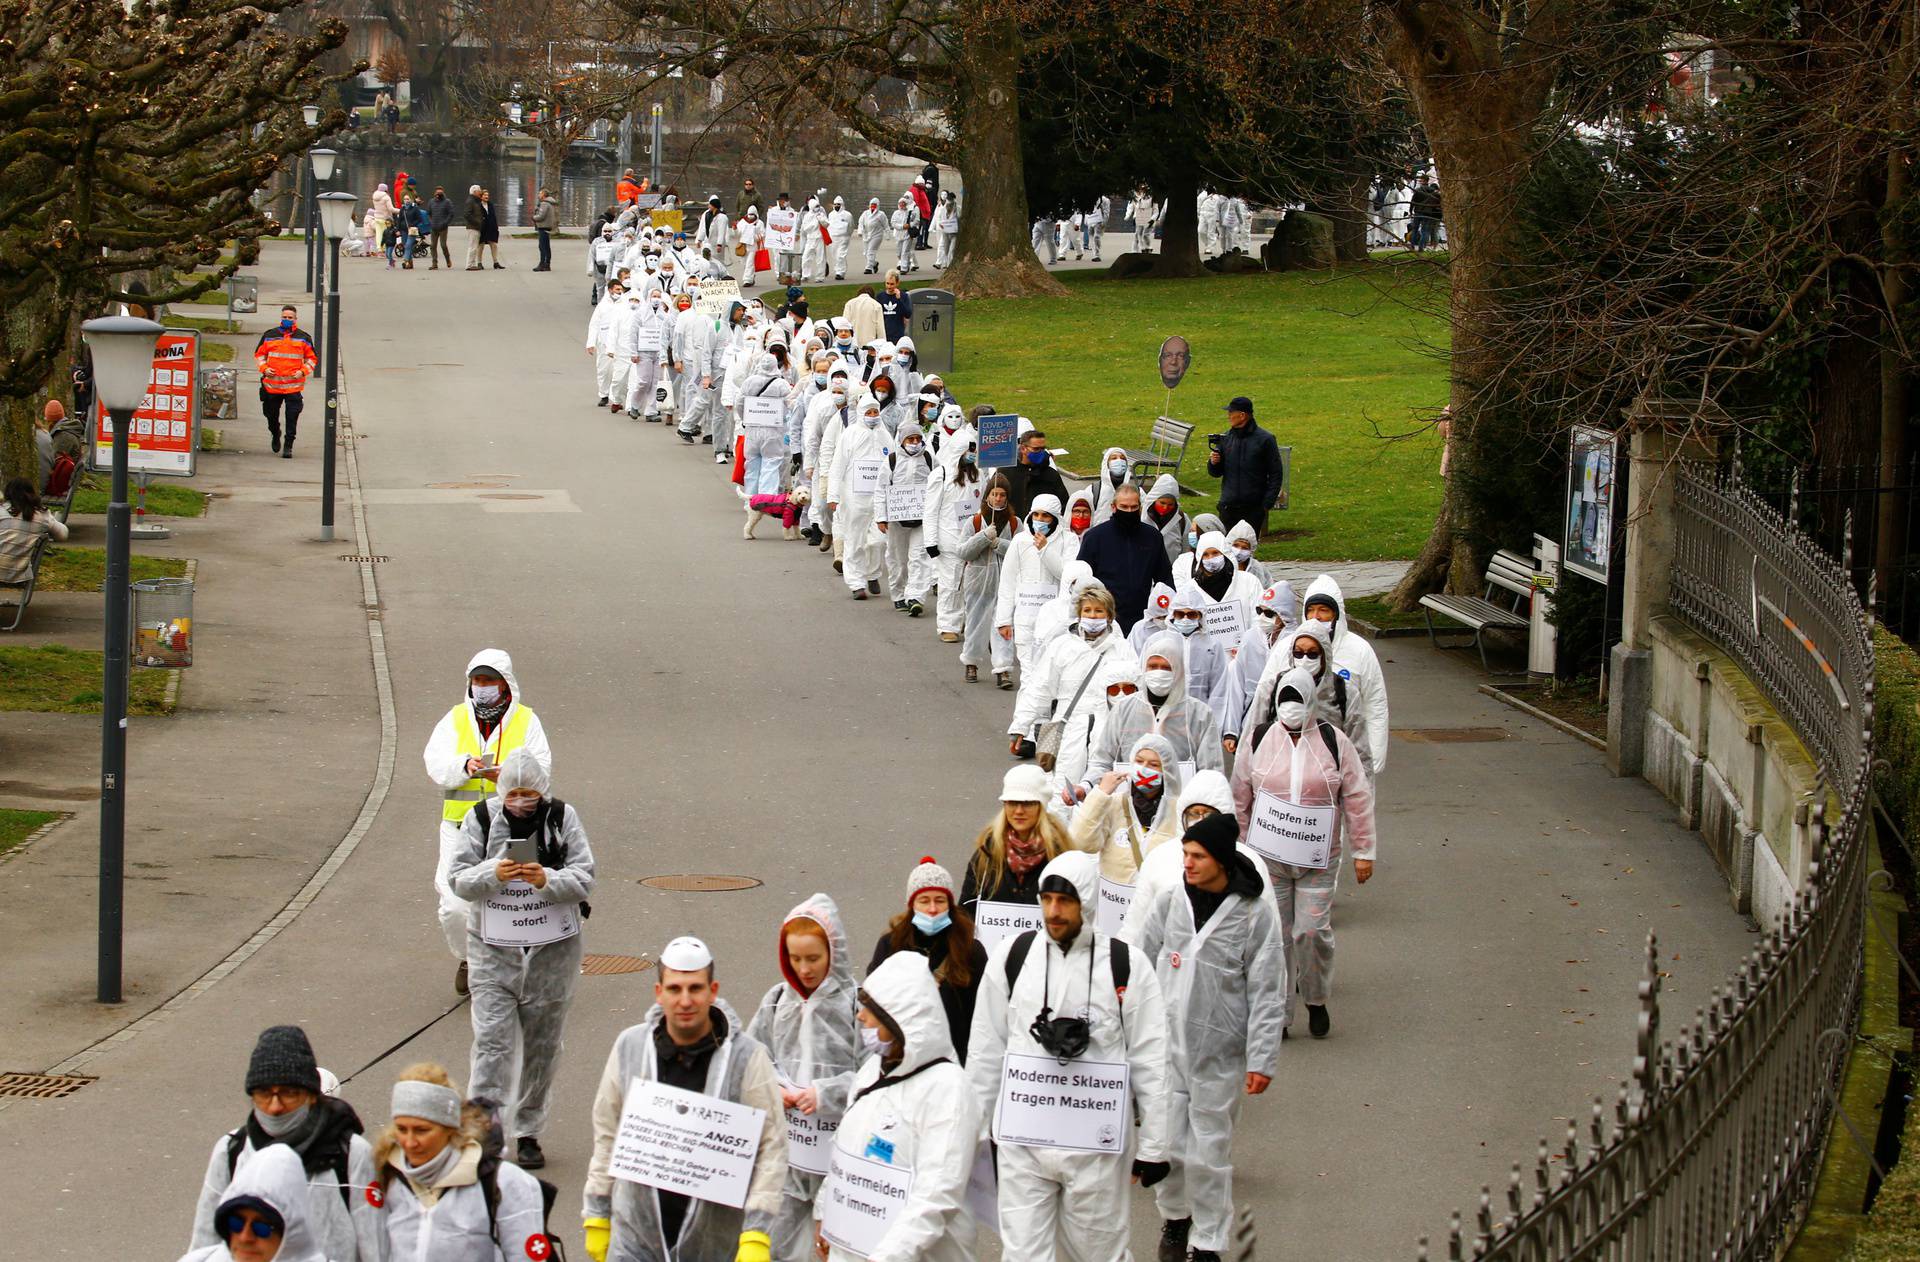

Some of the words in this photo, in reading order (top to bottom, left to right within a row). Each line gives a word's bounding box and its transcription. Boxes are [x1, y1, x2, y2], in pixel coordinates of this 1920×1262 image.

[981, 433, 1014, 444] RESET
[1208, 625, 1240, 636] einwohl!
[1268, 807, 1301, 825] Impfen
[1304, 816, 1317, 826] ist
[1256, 817, 1326, 843] Nächstenliebe!
[1101, 889, 1126, 904] Maske
[512, 915, 548, 927] sofort!
[981, 915, 1010, 927] Lasst
[1013, 916, 1032, 929] die
[1007, 1068, 1068, 1086] Moderne
[1071, 1075, 1124, 1090] Sklaven
[1010, 1091, 1055, 1107] tragen
[1060, 1096, 1117, 1111] Masken!
[816, 1119, 840, 1132] las
[686, 1160, 710, 1173] Gates
[655, 1172, 670, 1181] NO
[671, 1175, 692, 1187] WAY
[691, 1171, 711, 1181] bald
[845, 1171, 906, 1200] vermeiden
[847, 1194, 887, 1220] immer!
